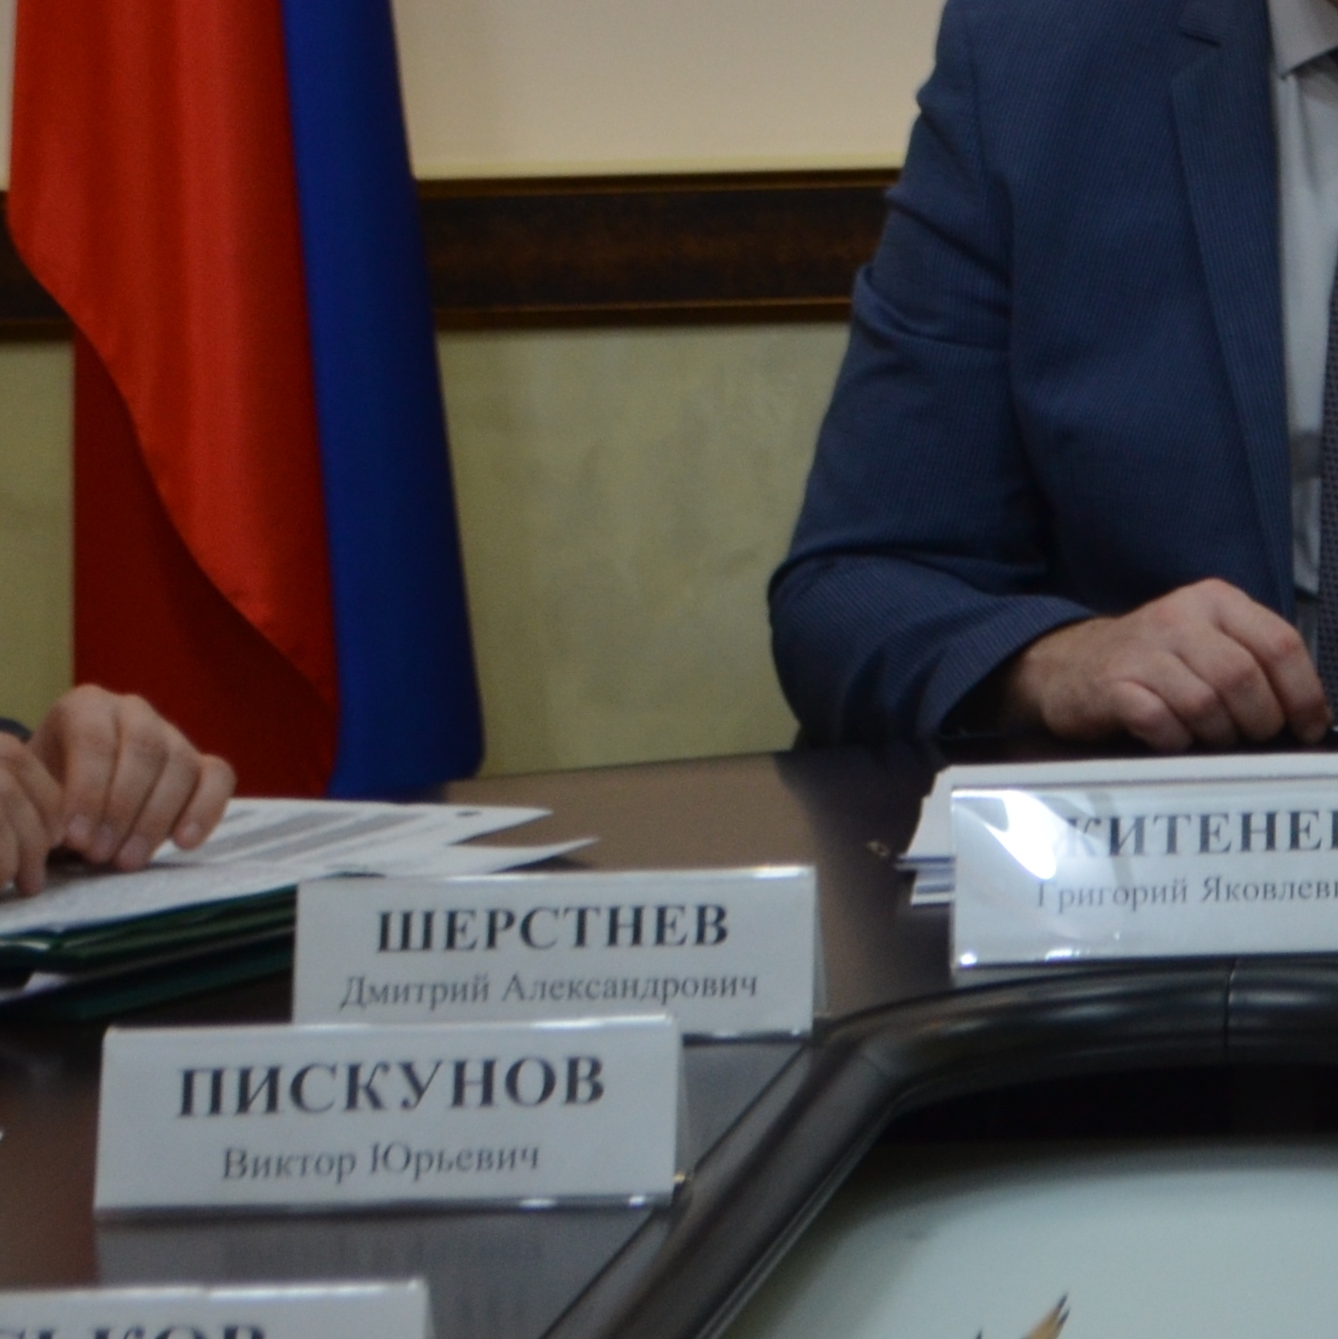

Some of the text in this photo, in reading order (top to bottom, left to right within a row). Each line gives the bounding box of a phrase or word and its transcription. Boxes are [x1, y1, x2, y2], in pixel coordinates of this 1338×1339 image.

[1035, 875, 1188, 913] Григорий
[377, 903, 730, 953] ШЕРСТНЕВ
[338, 972, 759, 1011] Дмитрий Александрович
[177, 1055, 605, 1118] ПИСКУНОВ
[222, 1141, 541, 1183] Виктор Юрьевич
